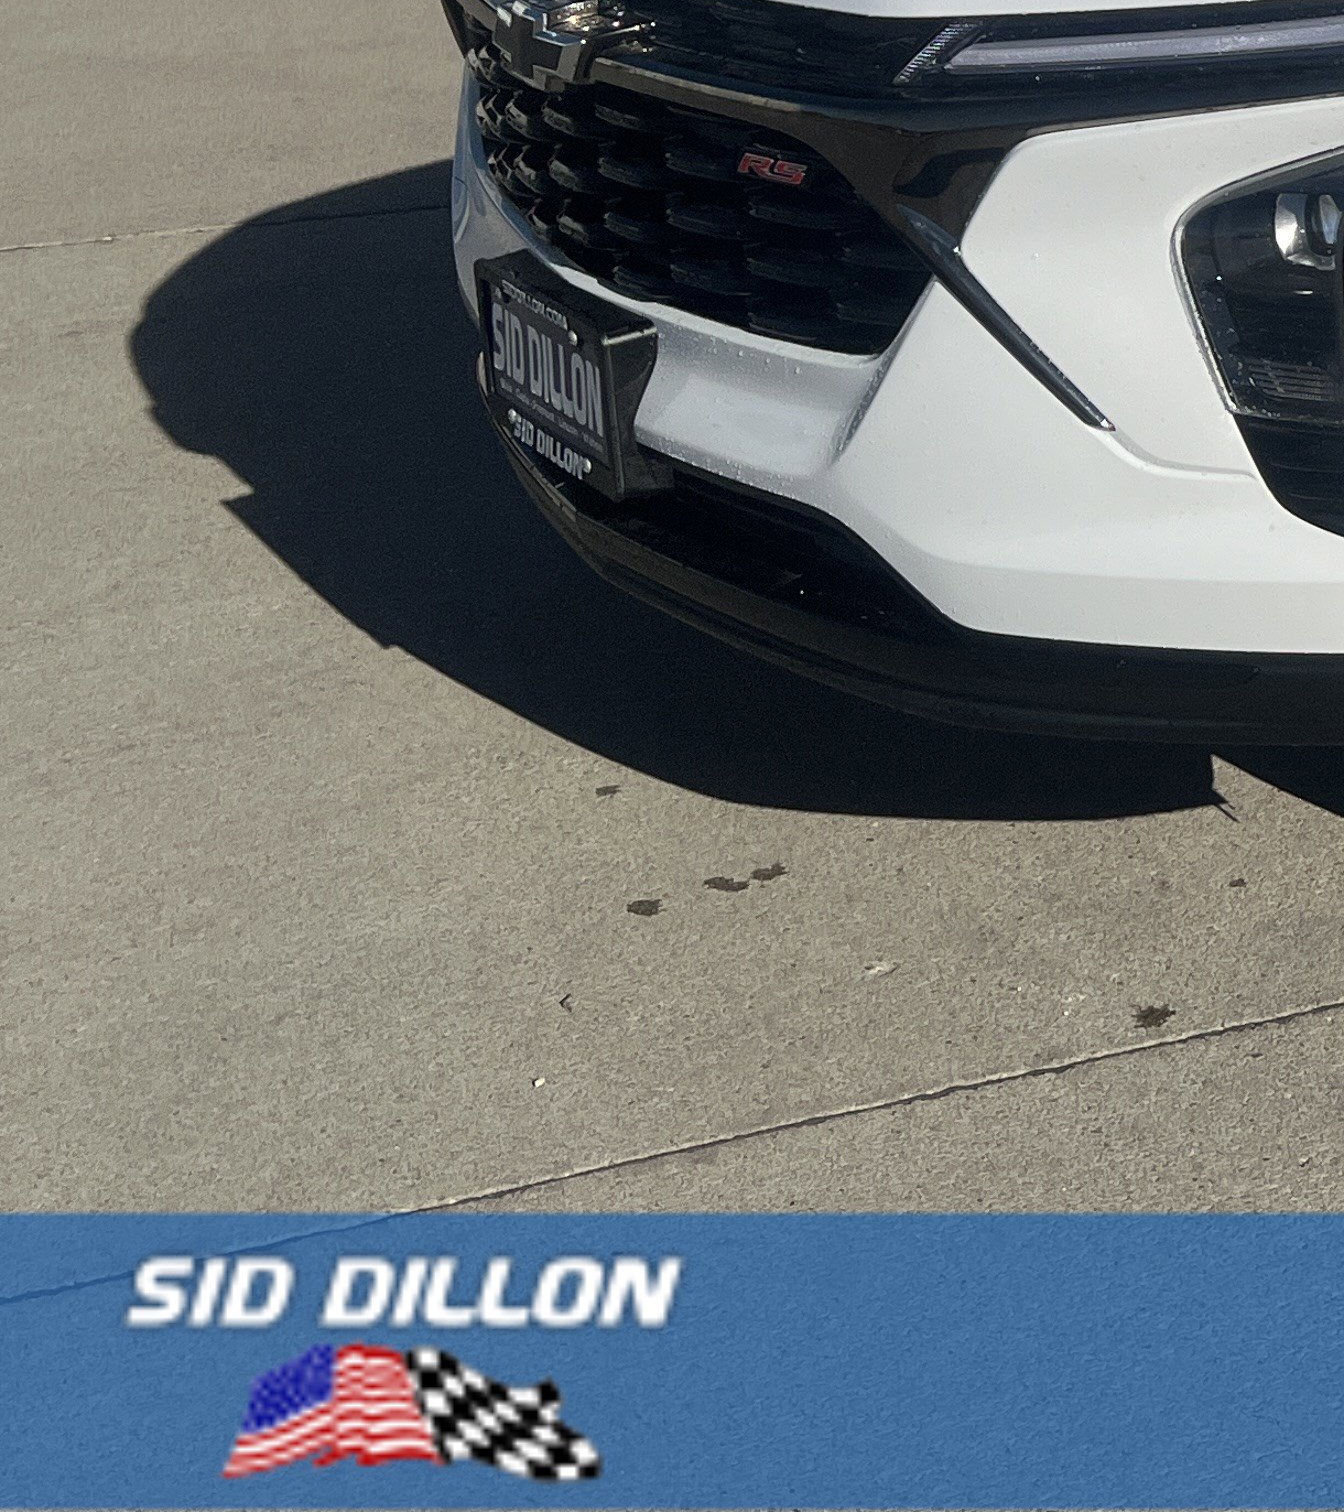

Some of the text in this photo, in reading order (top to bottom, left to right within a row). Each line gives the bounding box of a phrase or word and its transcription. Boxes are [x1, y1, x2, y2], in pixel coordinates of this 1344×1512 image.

[737, 152, 808, 185] RS
[491, 302, 525, 386] SID
[527, 324, 604, 438] DILLON
[536, 428, 585, 481] DILLON
